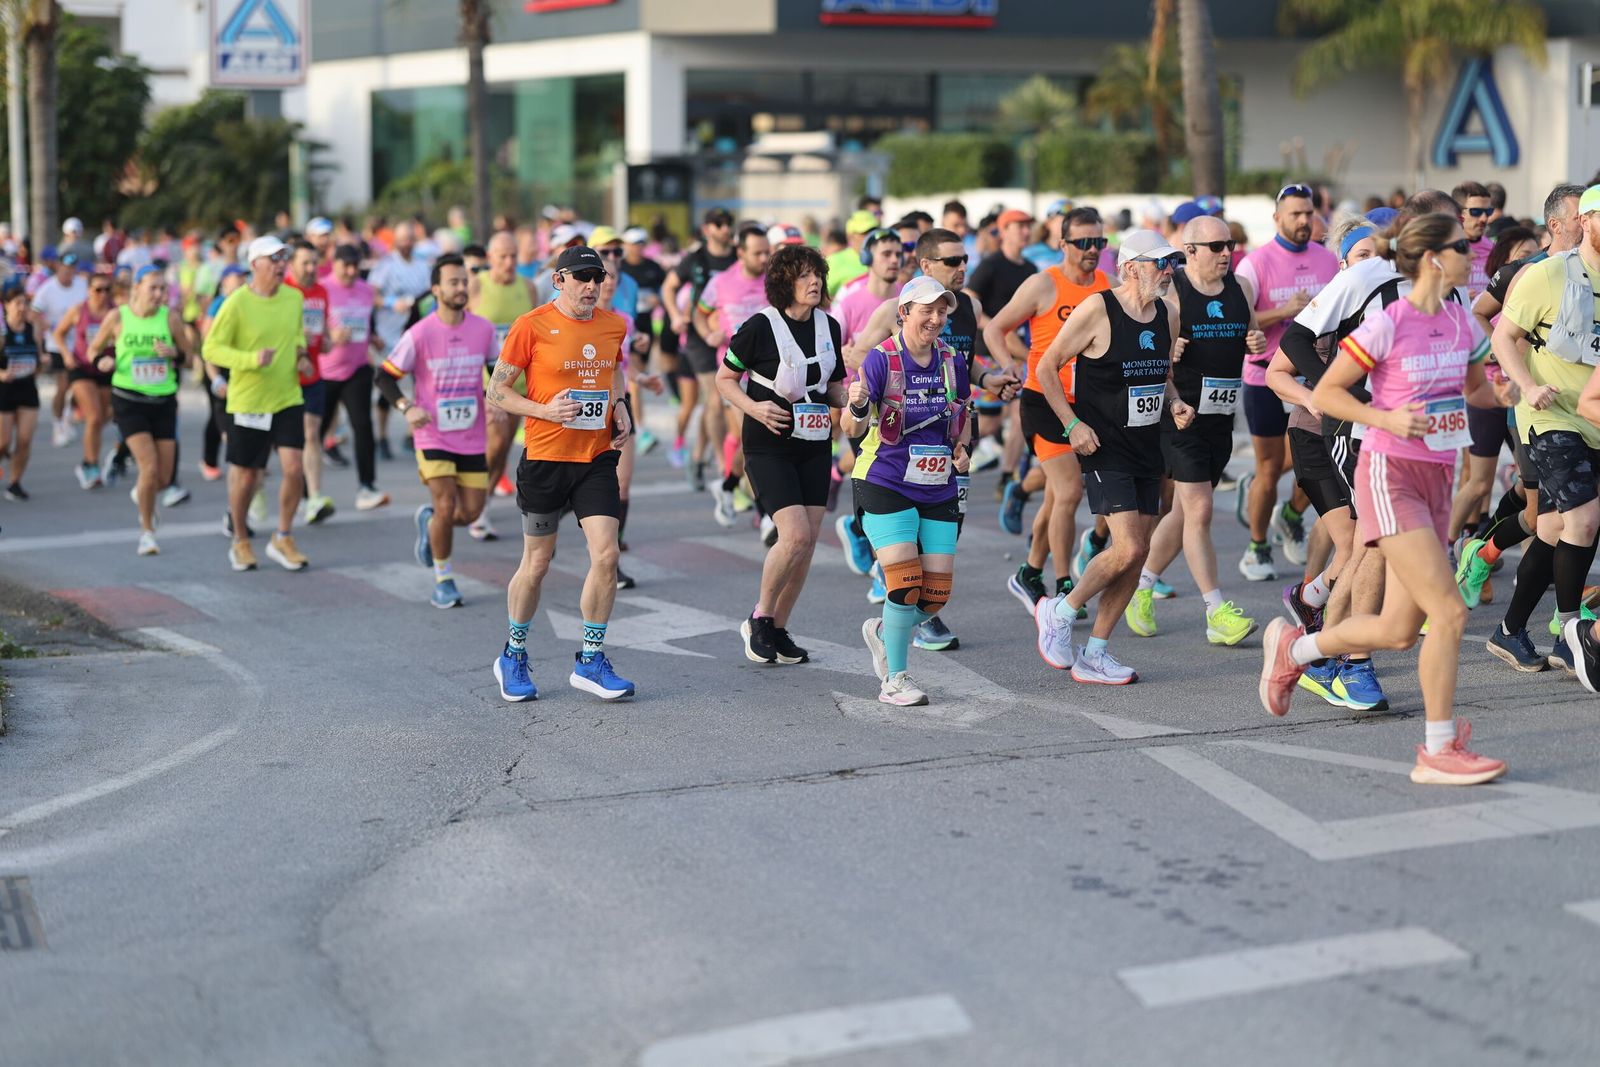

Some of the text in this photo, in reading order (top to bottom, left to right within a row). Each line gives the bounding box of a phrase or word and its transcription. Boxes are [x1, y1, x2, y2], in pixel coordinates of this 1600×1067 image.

[564, 360, 612, 370] BENIDORM
[578, 369, 600, 377] HALF
[1123, 368, 1164, 377] SPARTANS
[1209, 389, 1237, 403] 445
[1137, 396, 1160, 413] 930
[446, 407, 471, 420] 175
[799, 414, 830, 428] 1283
[1426, 412, 1466, 434] 2496
[916, 457, 947, 472] 492
